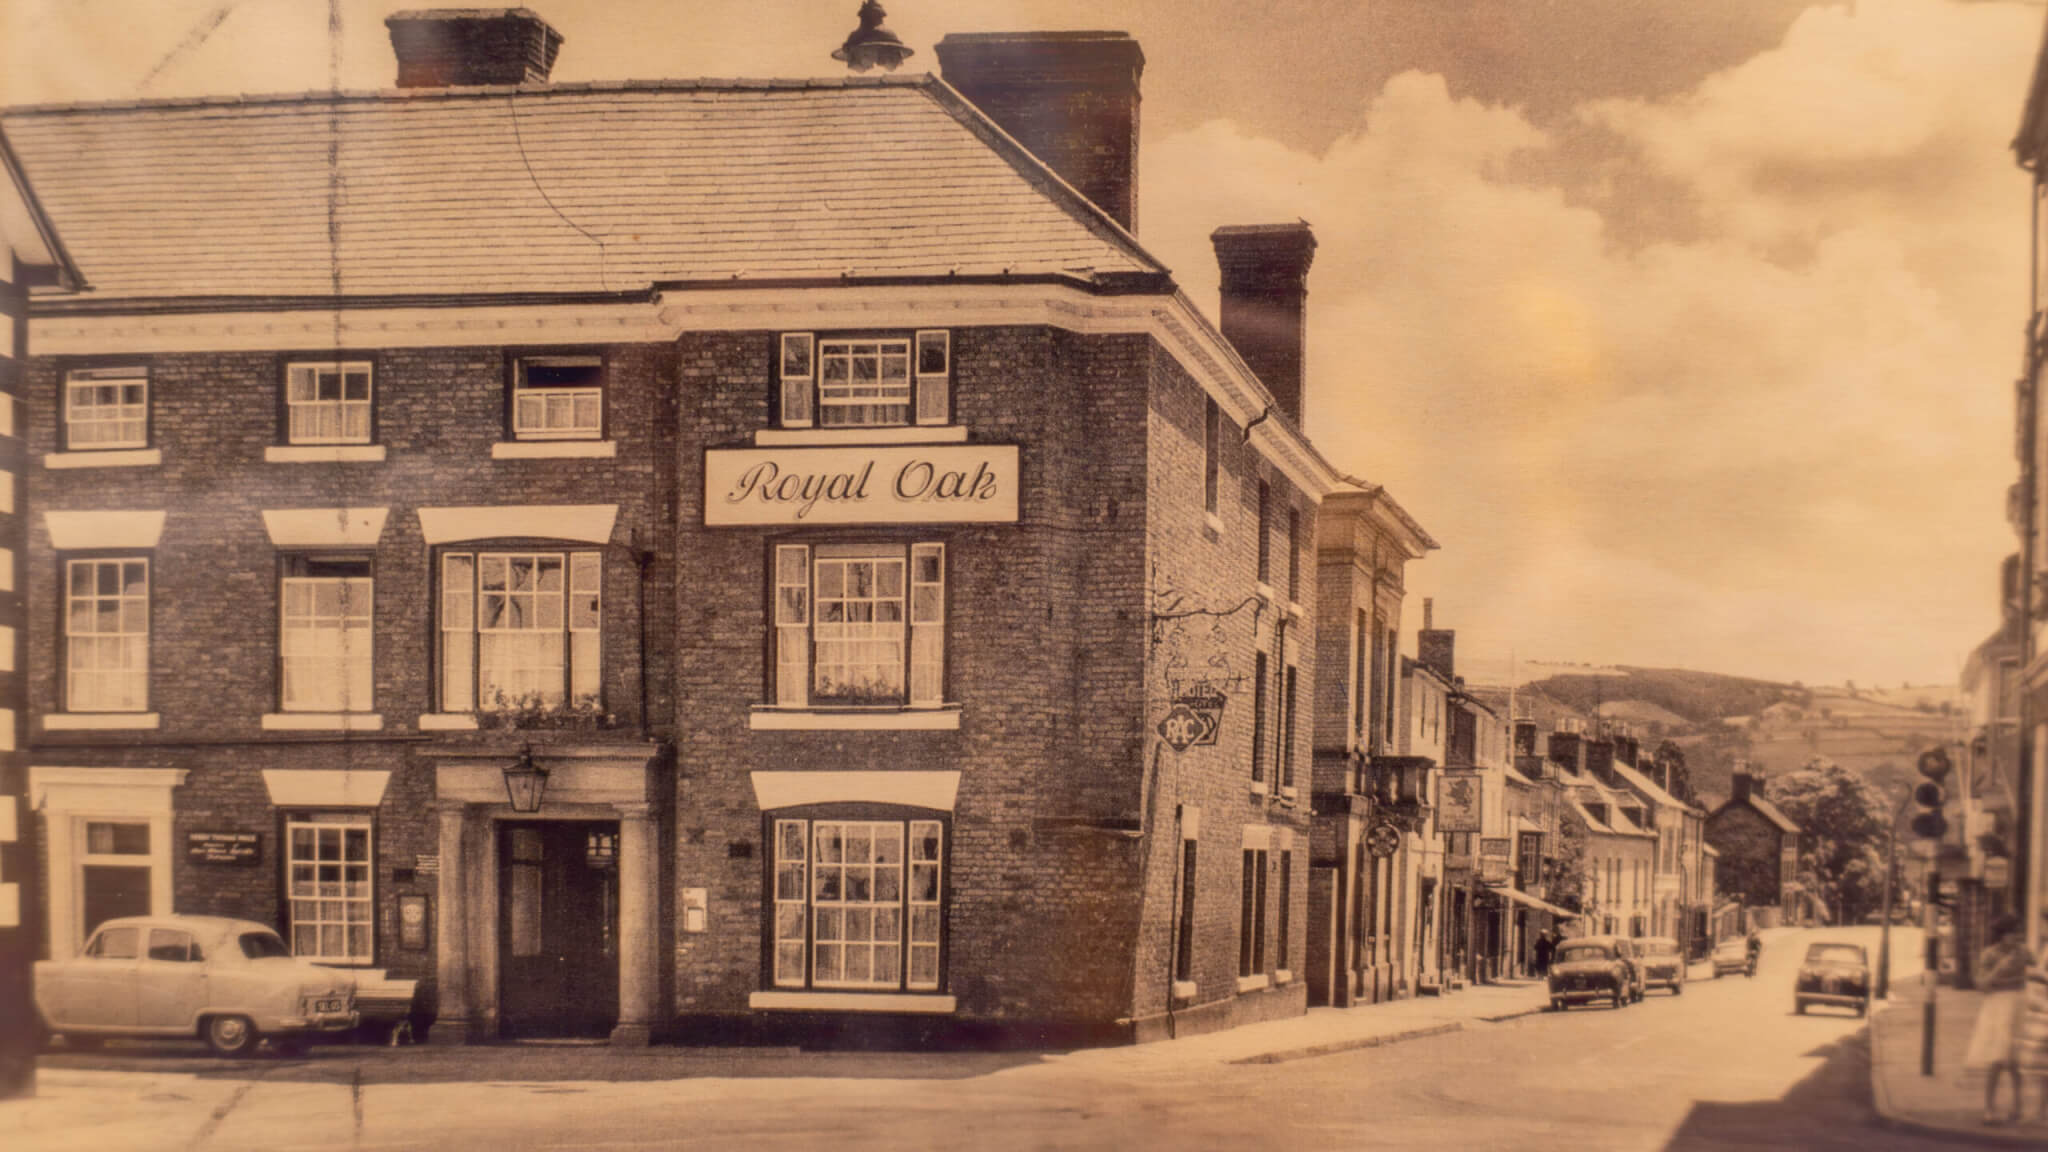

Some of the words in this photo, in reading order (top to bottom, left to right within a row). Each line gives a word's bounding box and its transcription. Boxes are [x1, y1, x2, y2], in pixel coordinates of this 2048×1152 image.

[727, 460, 876, 519] Royal
[892, 459, 997, 501] Oak
[1166, 714, 1195, 744] RAC
